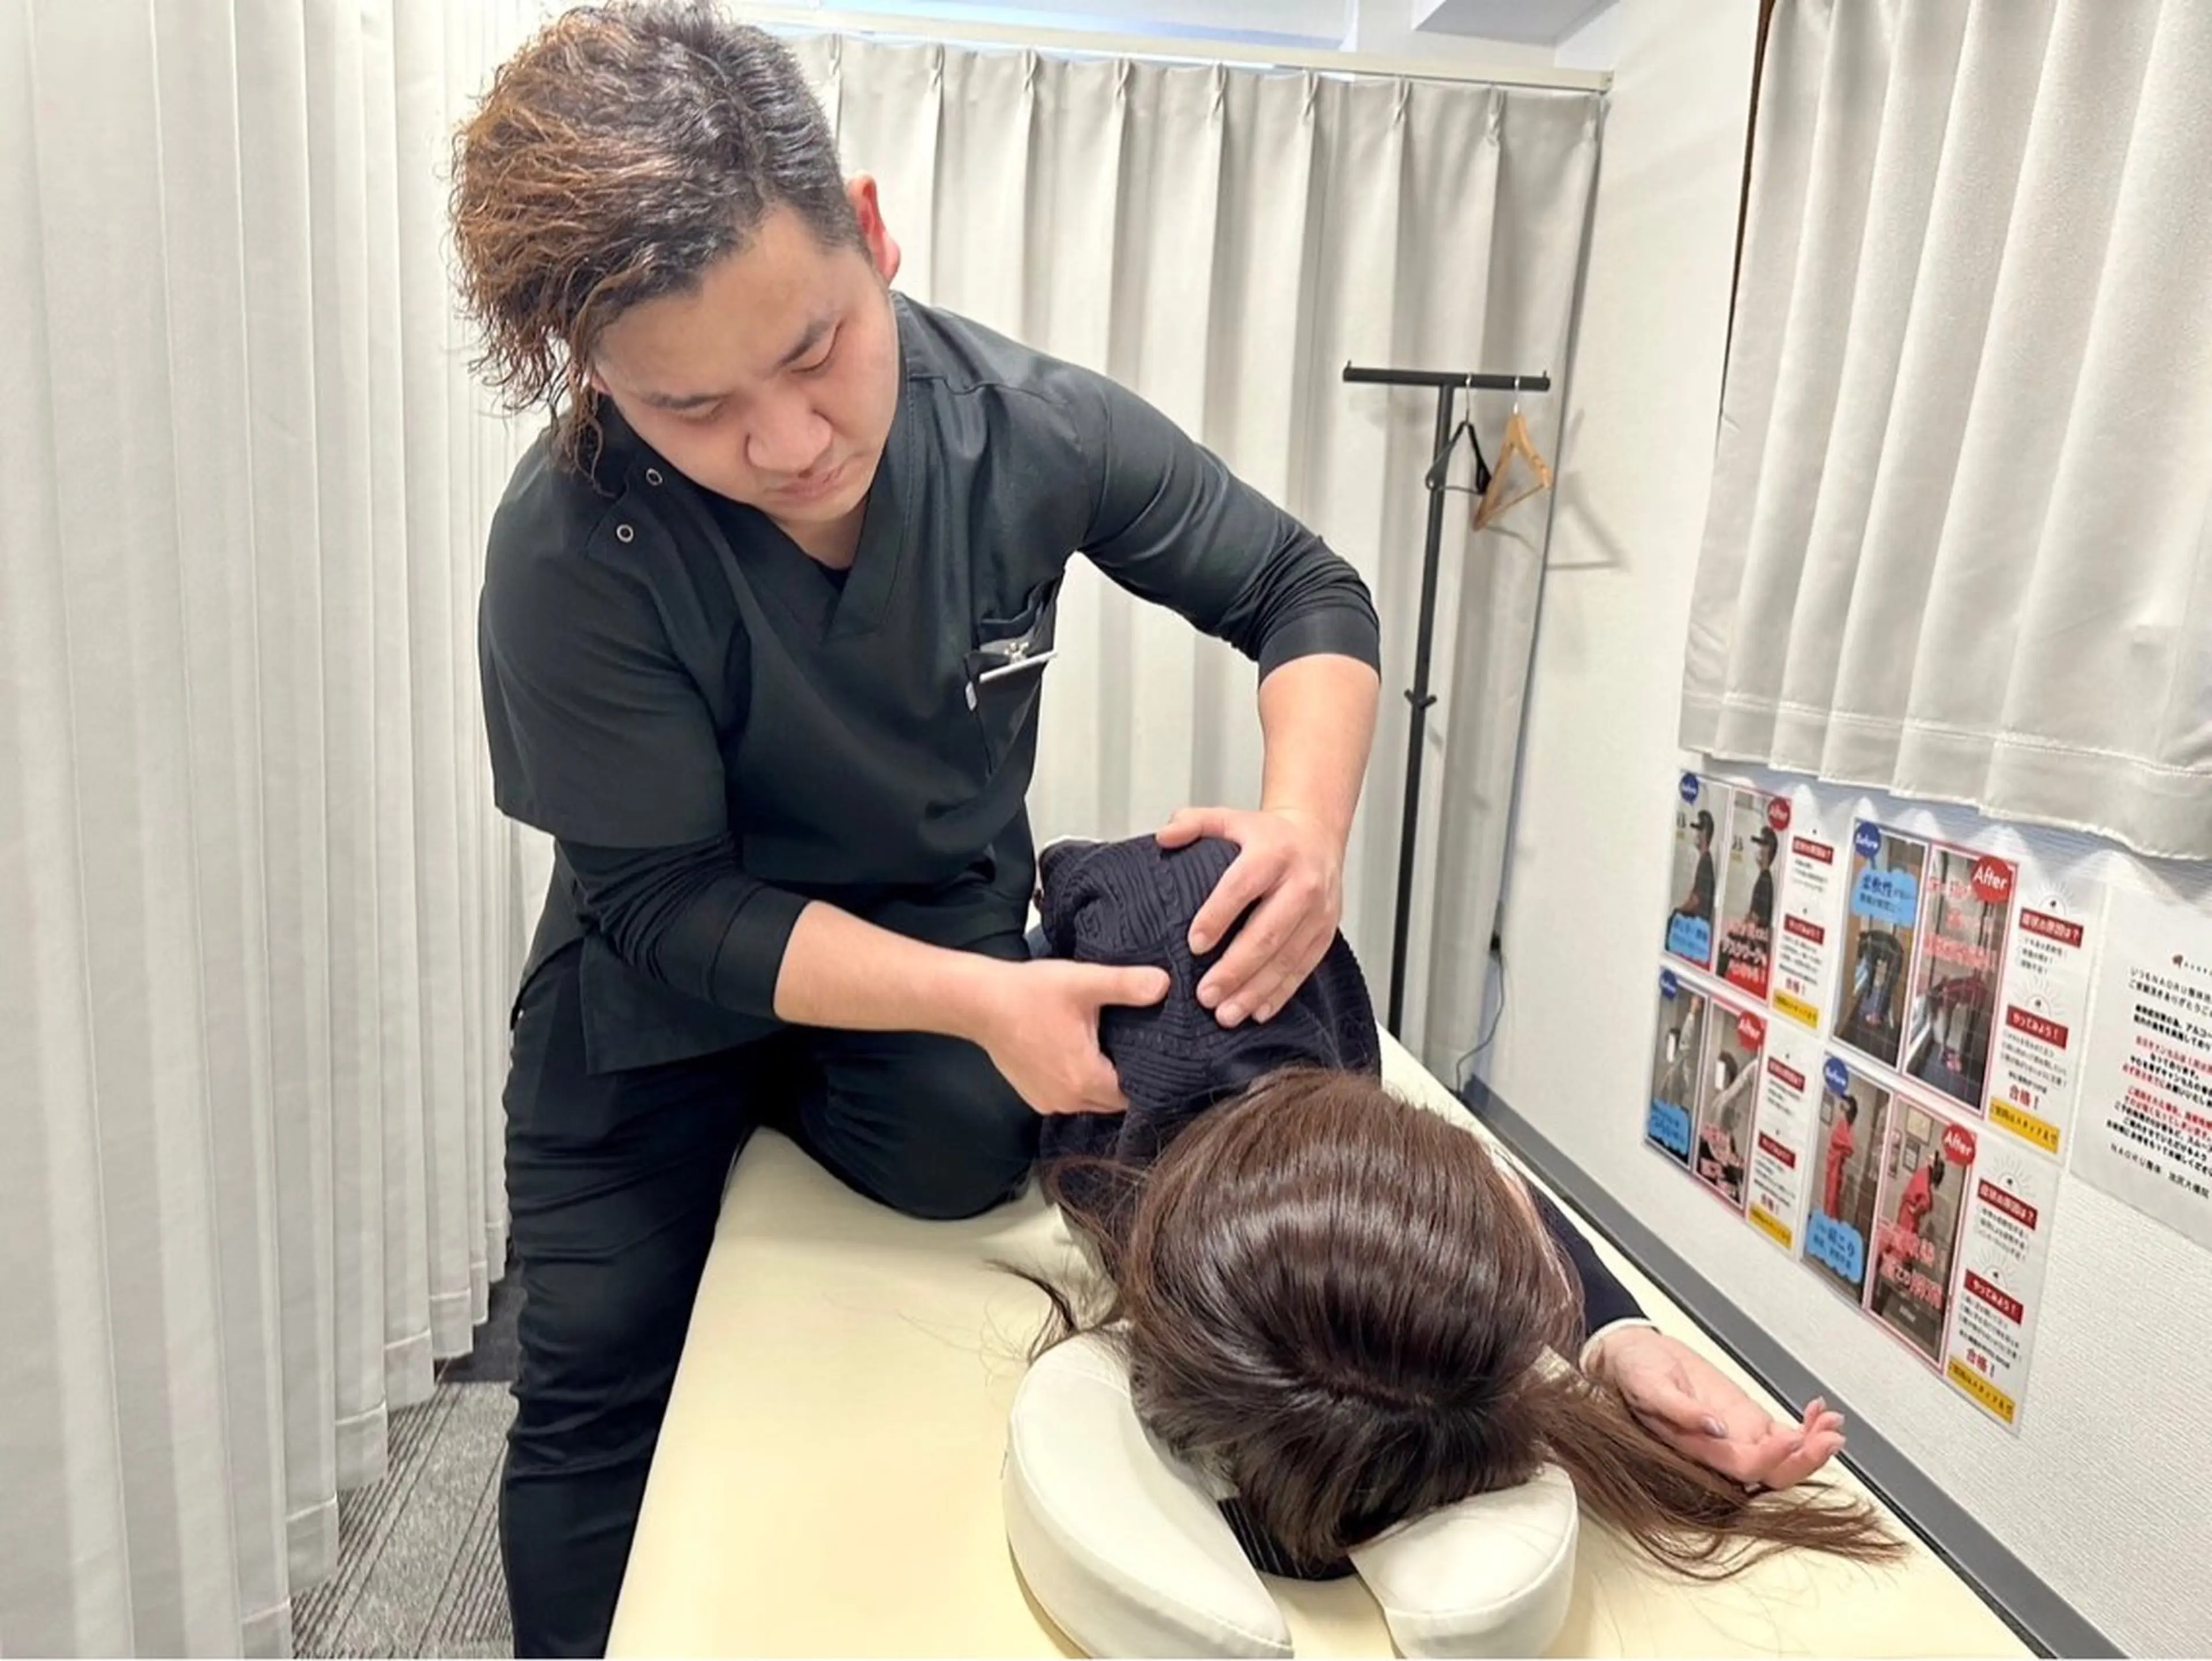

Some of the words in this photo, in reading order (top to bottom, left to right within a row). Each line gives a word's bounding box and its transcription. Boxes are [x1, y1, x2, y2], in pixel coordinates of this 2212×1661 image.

[1856, 834, 1878, 850] Before
[1972, 866, 2007, 890] After
[2009, 1083, 2040, 1110] 合格！
[1944, 1132, 1972, 1156] After
